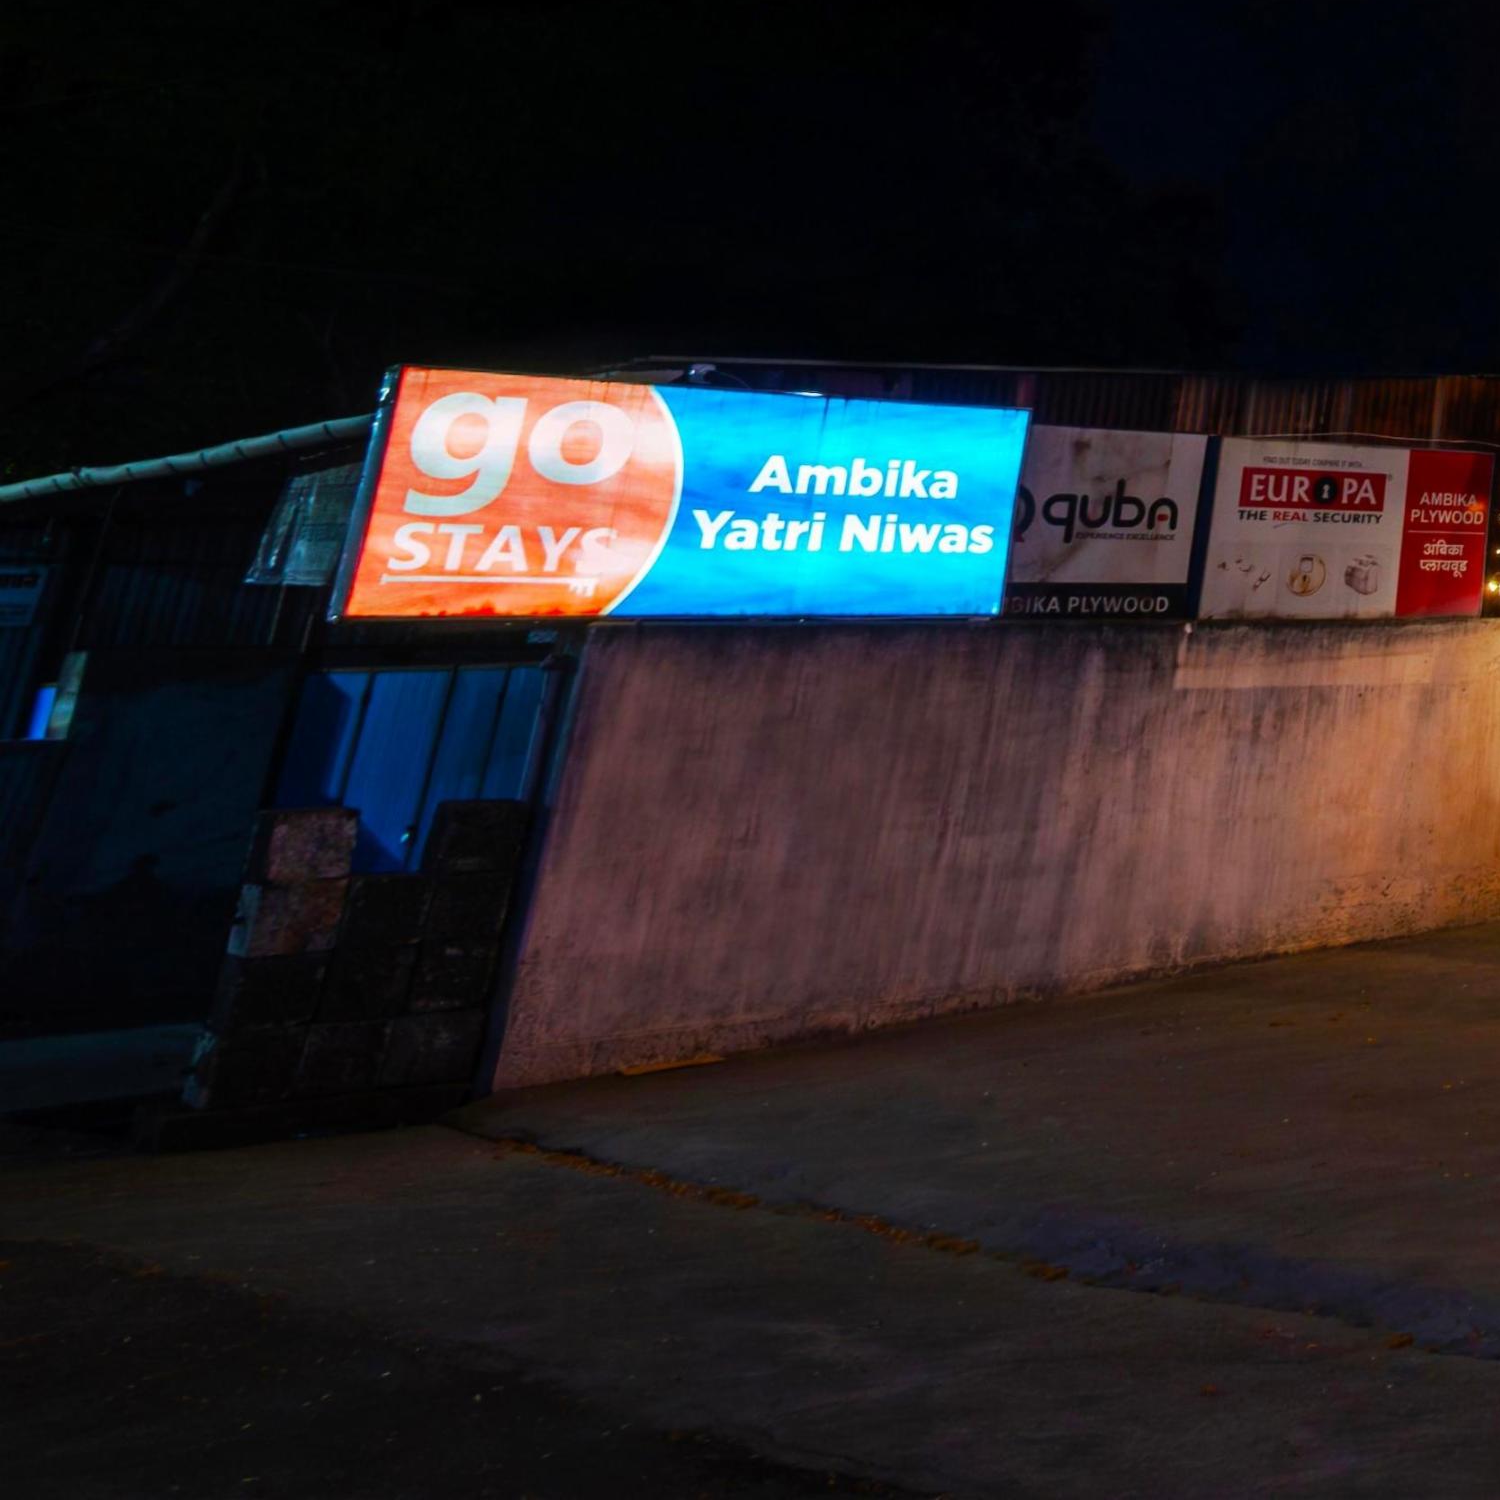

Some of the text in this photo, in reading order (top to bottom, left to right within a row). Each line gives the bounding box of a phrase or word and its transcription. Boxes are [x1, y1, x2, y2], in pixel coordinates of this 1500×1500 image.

[403, 390, 635, 516] go
[748, 454, 959, 500] Ambika
[1249, 473, 1377, 505] EUROPA
[1042, 478, 1179, 544] quba
[1420, 491, 1477, 506] AMBIKA
[1238, 510, 1383, 524] THE REAL SECURITY
[1410, 509, 1484, 525] PLYWOOD
[691, 509, 824, 553] Yatri
[838, 513, 995, 556] Niwas
[387, 522, 618, 574] STAYS
[1423, 538, 1464, 556] अंबिका
[1419, 559, 1468, 578] प्लायवूड
[1067, 595, 1170, 614] PLYWOOD
